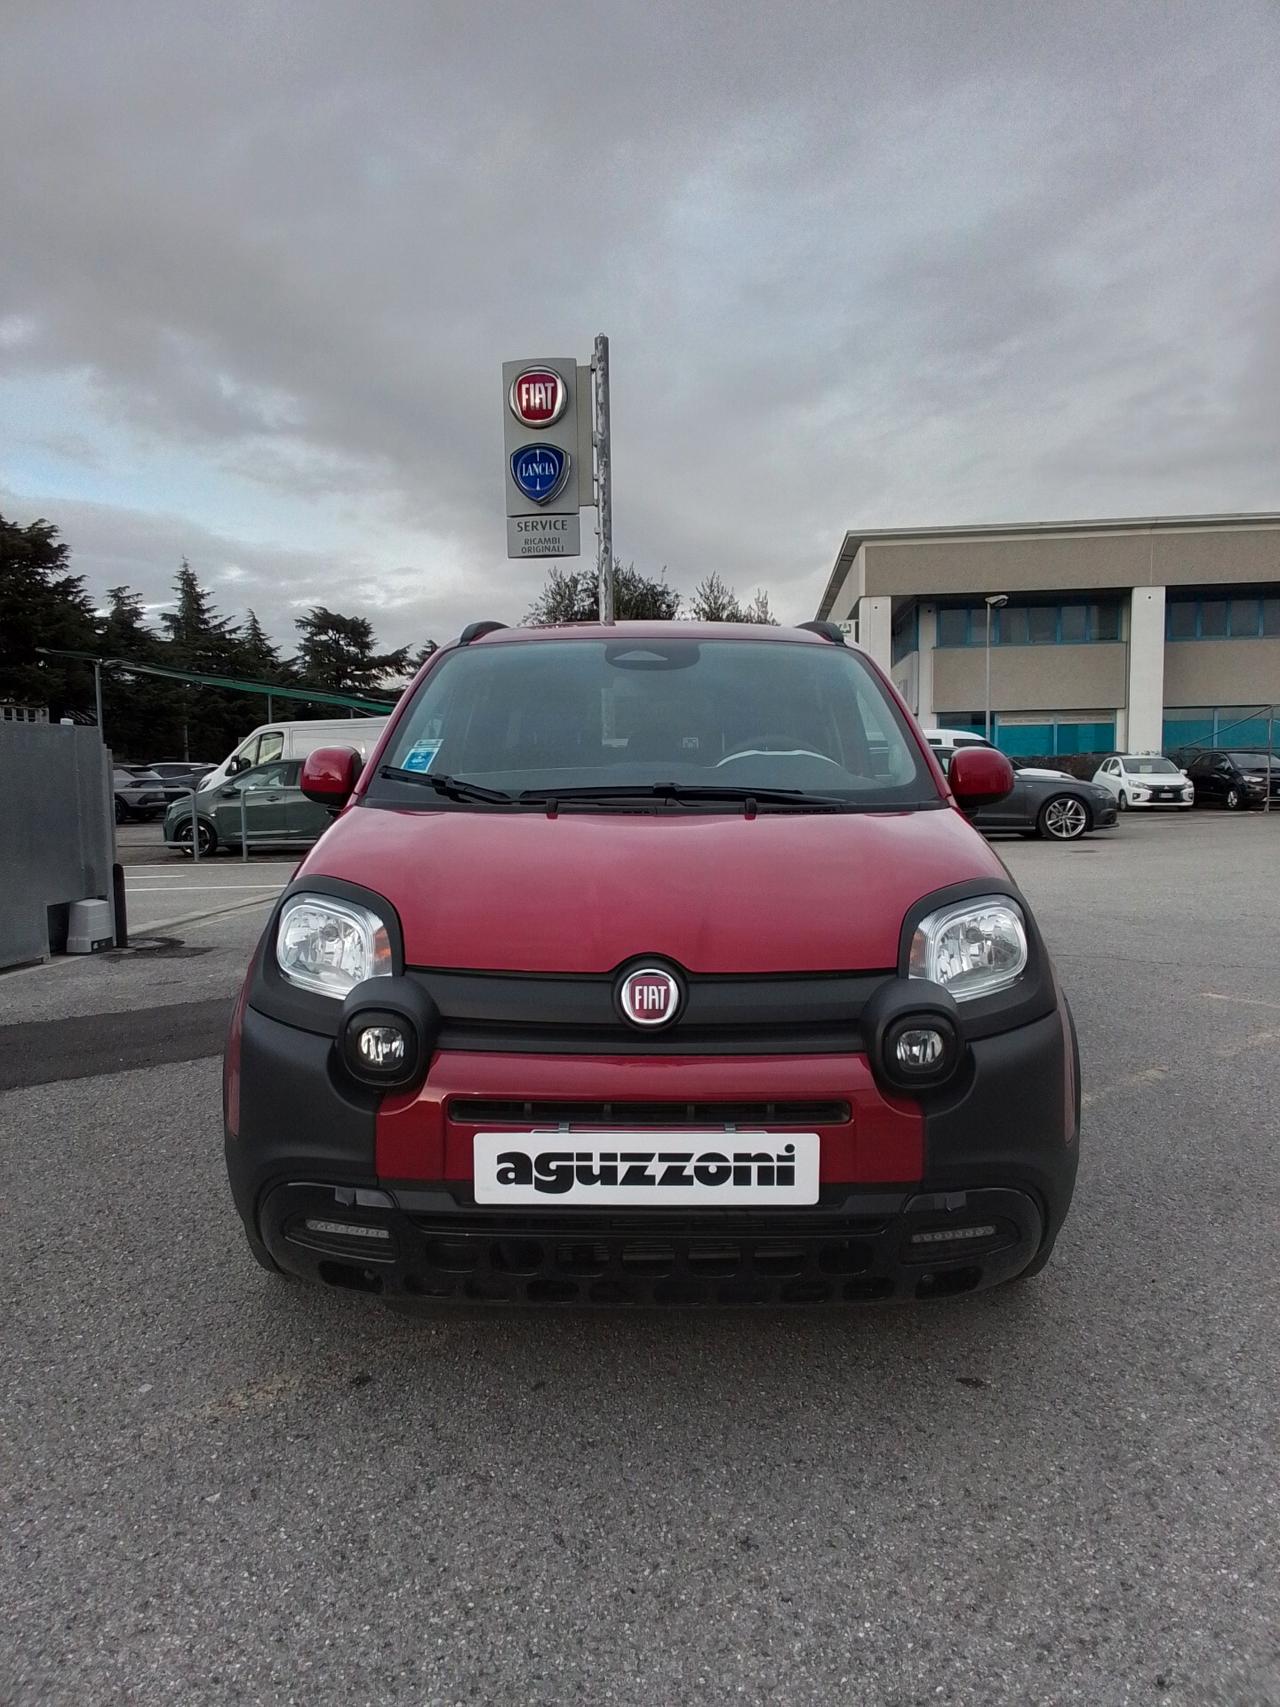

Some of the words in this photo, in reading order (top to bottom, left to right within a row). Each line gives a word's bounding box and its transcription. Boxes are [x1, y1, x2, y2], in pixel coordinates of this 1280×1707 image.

[521, 383, 555, 410] FIAT
[522, 462, 555, 477] LANCIA
[517, 519, 568, 533] SERVICE
[524, 536, 561, 546] RICAMBI
[521, 545, 564, 554] ORIGINALI
[635, 985, 667, 1010] FIAT
[496, 1143, 796, 1194] aguzzoni
